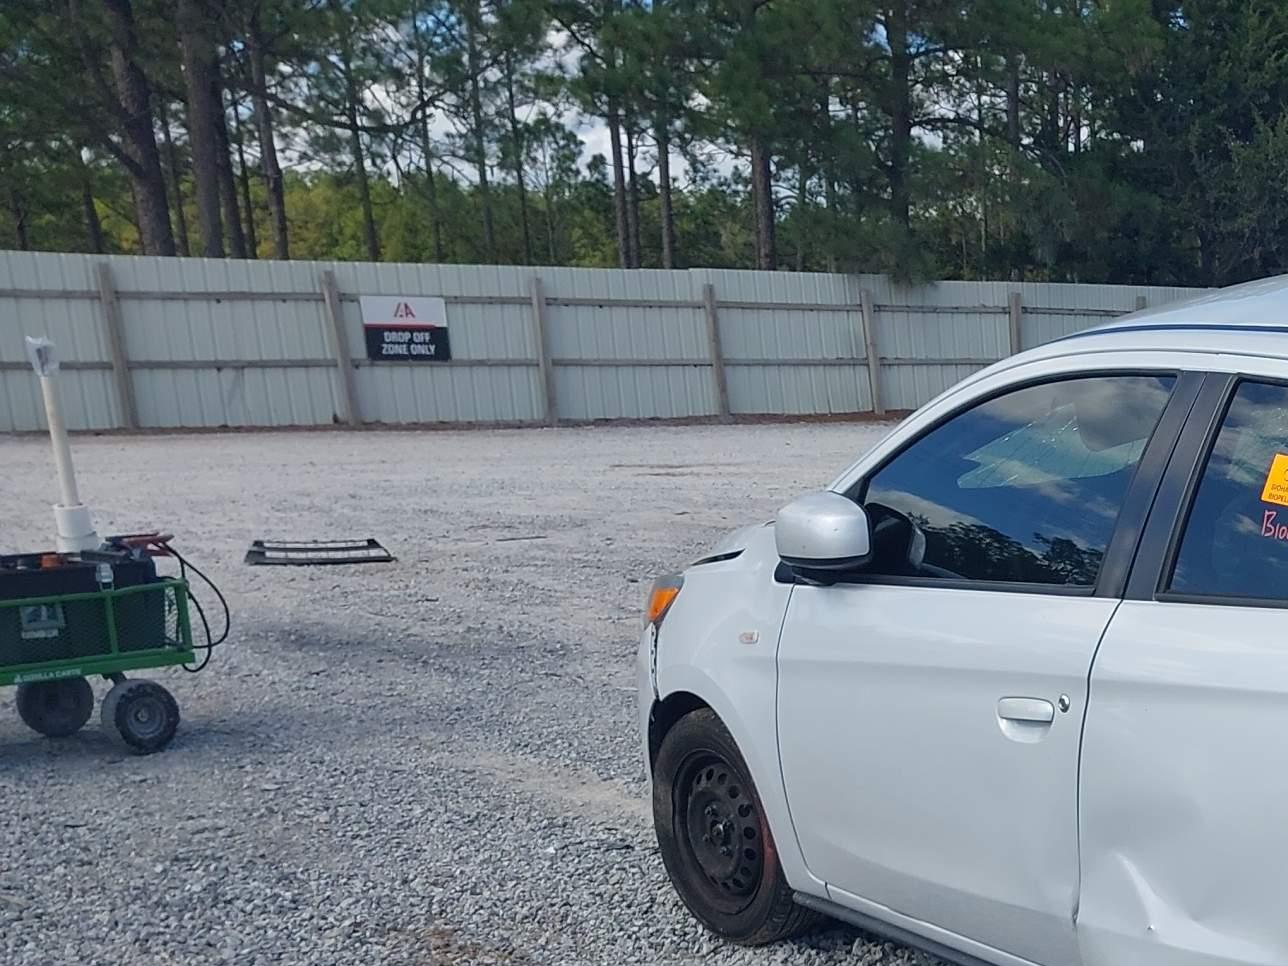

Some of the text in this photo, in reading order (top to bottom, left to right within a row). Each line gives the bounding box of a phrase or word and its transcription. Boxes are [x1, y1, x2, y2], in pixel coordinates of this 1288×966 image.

[384, 331, 431, 343] DROP OFF
[382, 343, 436, 355] ZONE ONLY
